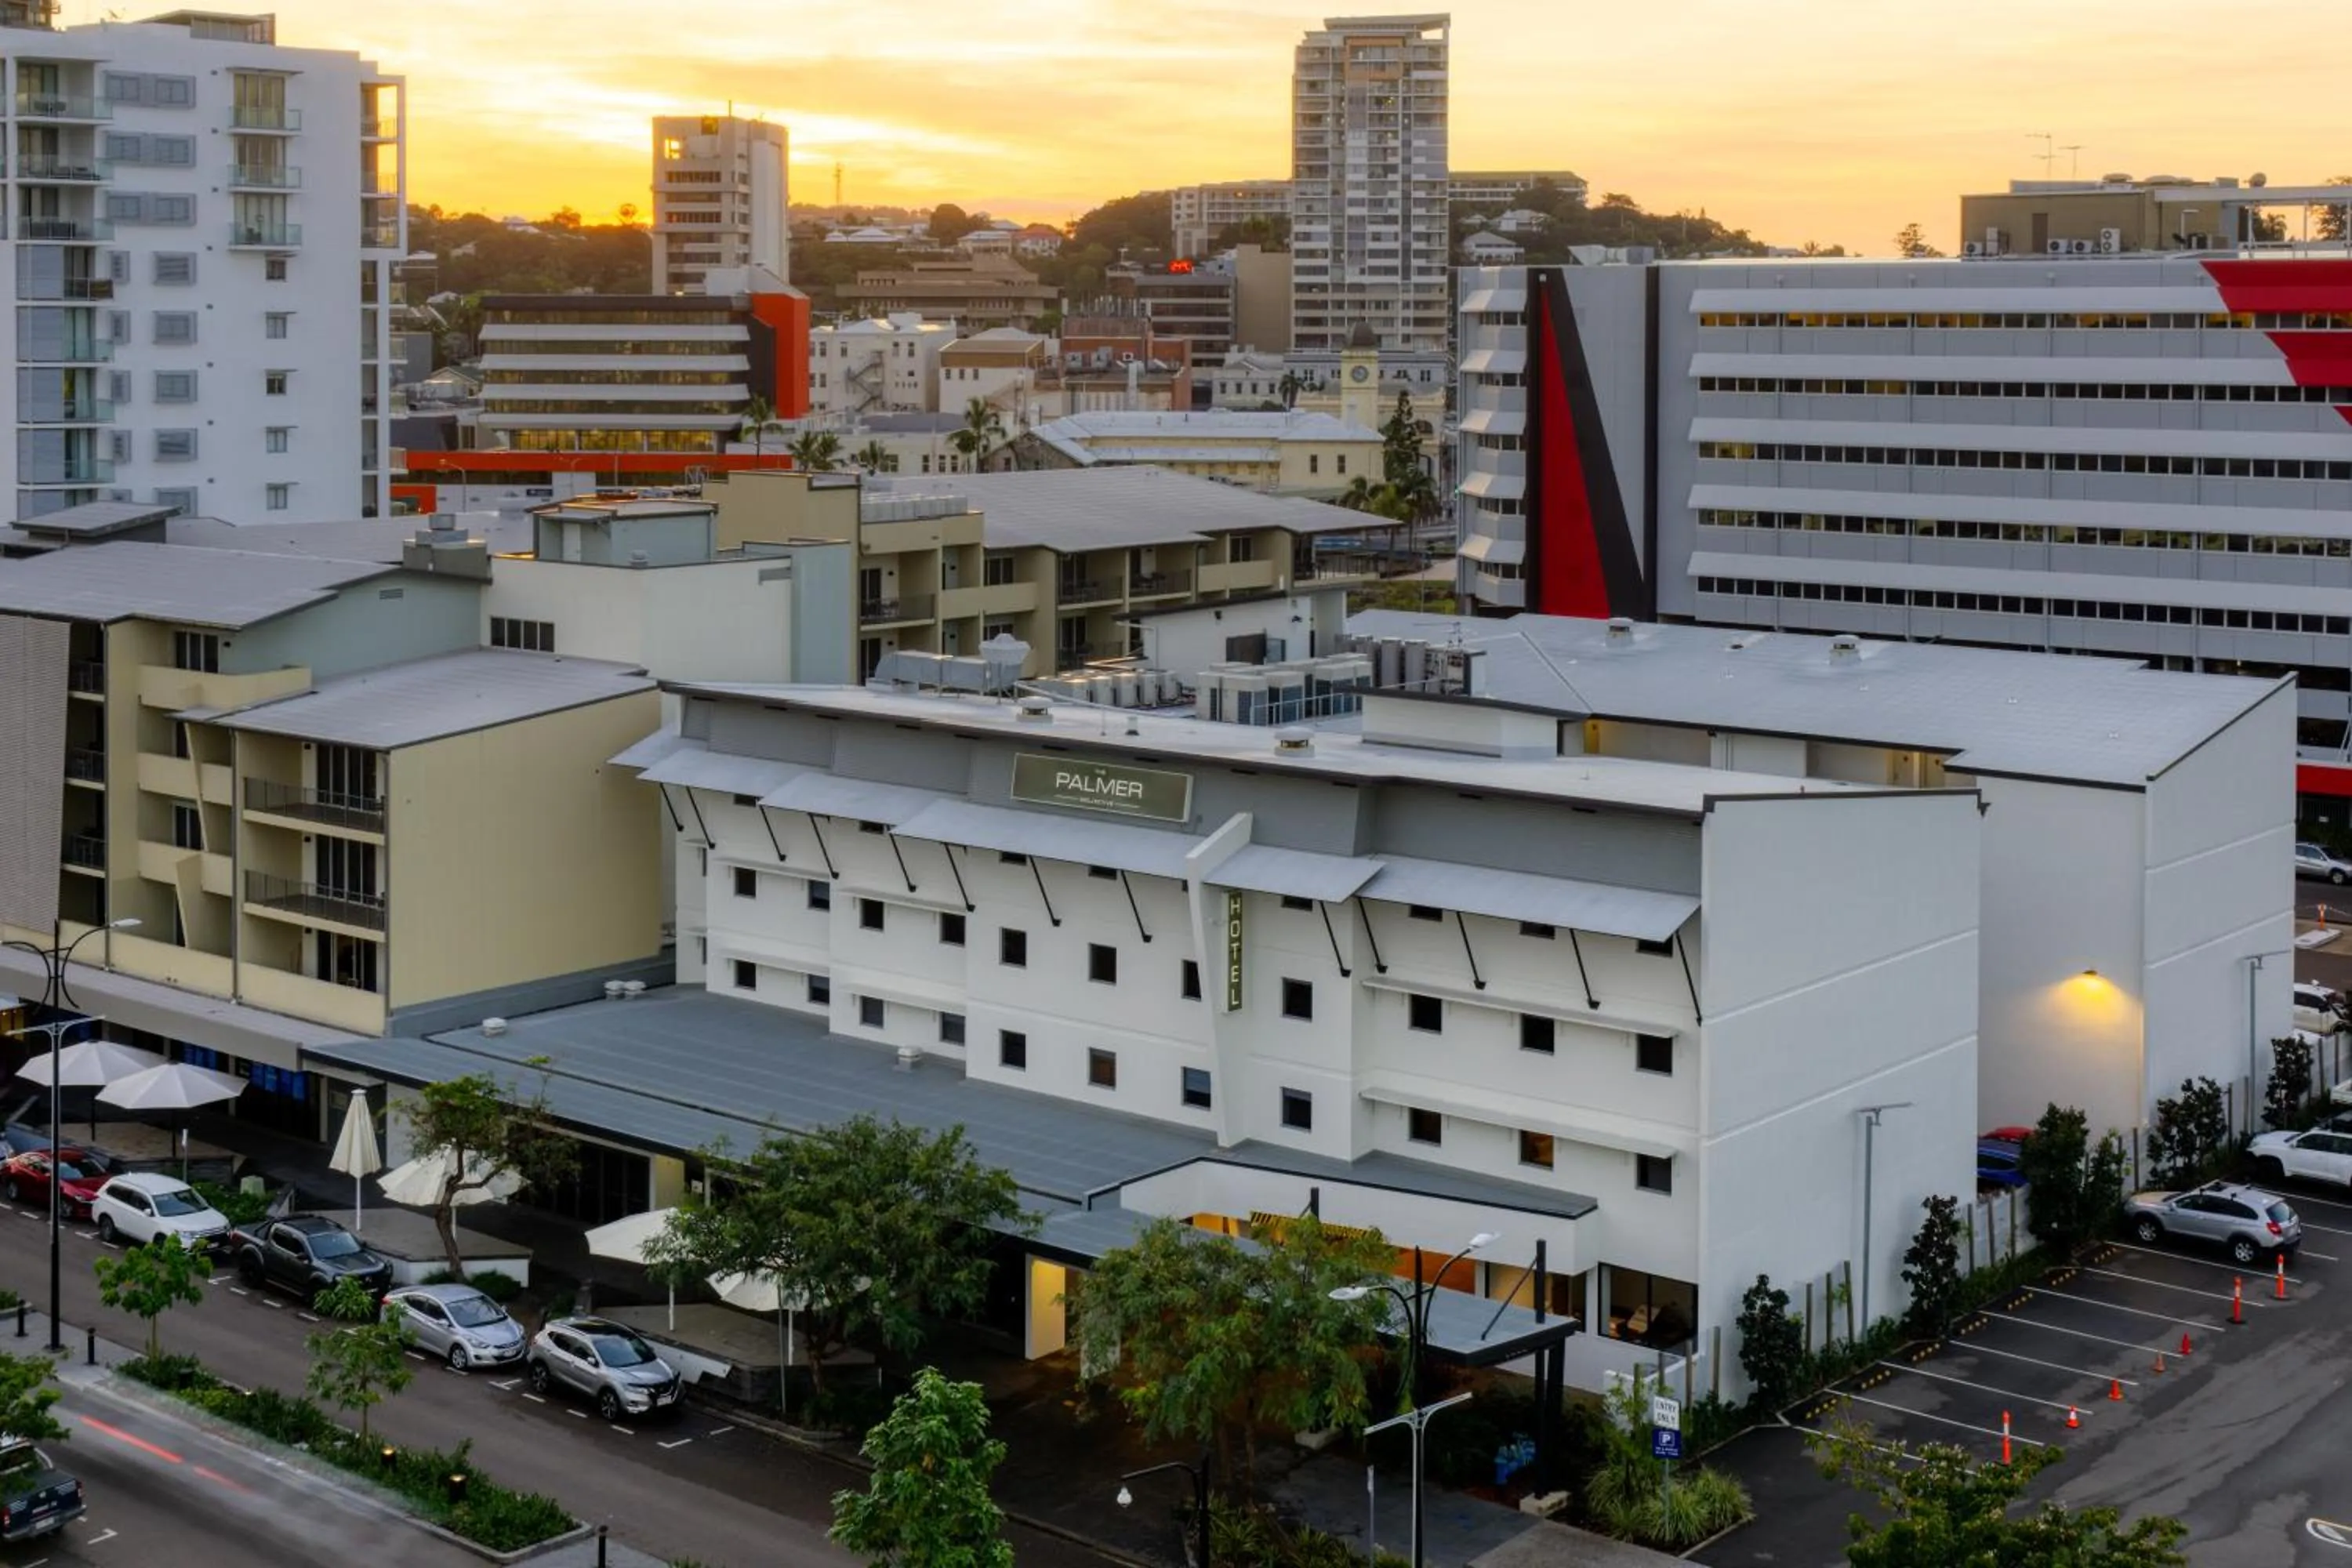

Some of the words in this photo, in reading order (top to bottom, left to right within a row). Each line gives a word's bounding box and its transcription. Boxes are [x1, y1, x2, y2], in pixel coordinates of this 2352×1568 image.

[1055, 771, 1143, 799] PALMER
[1230, 898, 1240, 1006] HOTEL
[1657, 1413, 1675, 1424] ONLY
[1661, 1434, 1671, 1443] P
